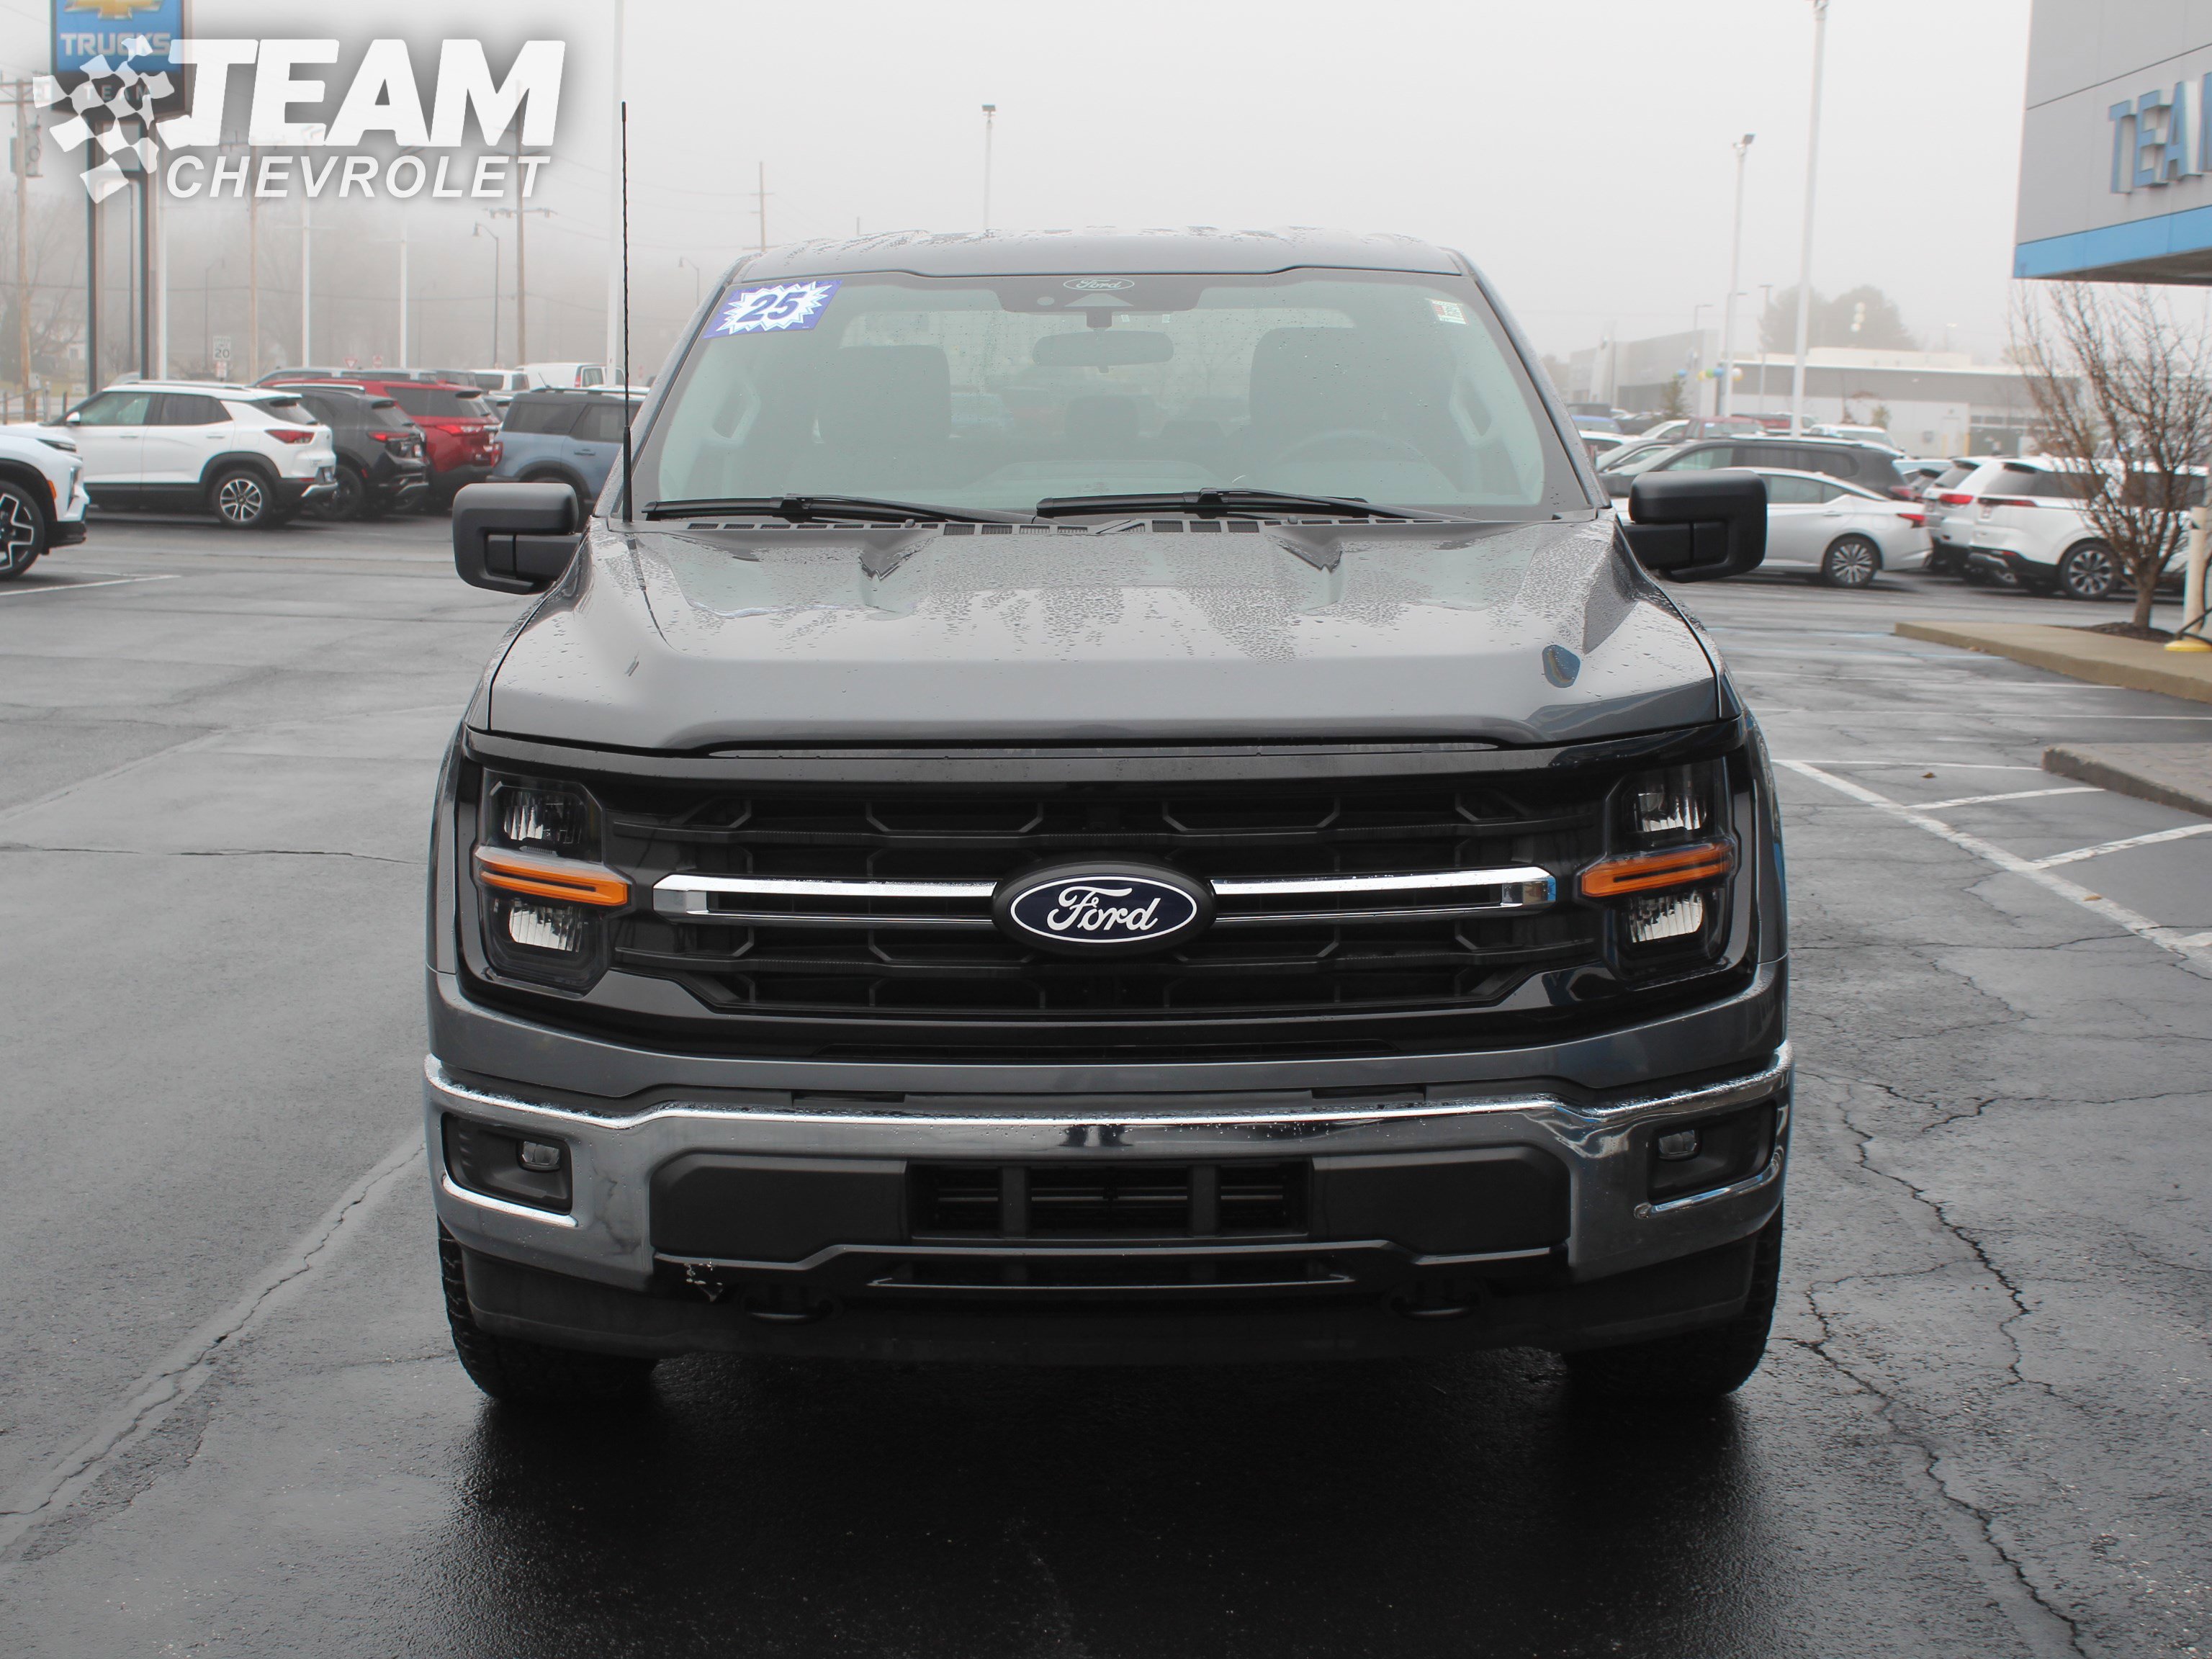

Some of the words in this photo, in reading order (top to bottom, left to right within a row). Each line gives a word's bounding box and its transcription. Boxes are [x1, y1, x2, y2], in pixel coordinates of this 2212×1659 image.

[60, 32, 171, 56] TRUCKS
[1076, 279, 1121, 289] Ford
[736, 292, 808, 323] 25
[215, 349, 230, 359] 20
[1047, 886, 1161, 931] Ford
